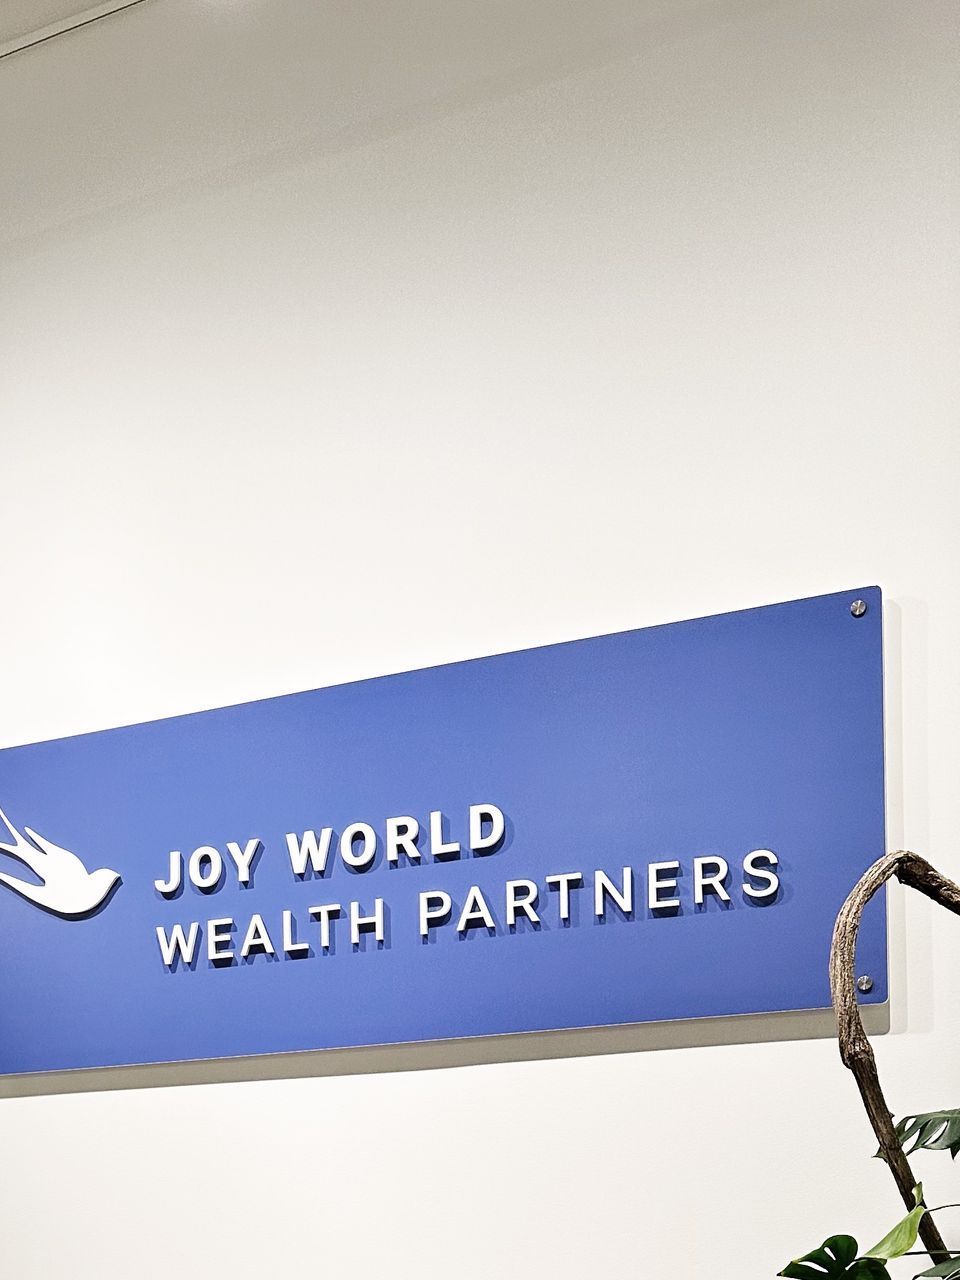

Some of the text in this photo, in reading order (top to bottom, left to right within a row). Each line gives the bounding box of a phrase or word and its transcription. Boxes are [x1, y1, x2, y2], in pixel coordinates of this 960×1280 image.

[153, 803, 506, 894] JOY WORLD
[155, 849, 780, 966] WEALTH PARTNERS
